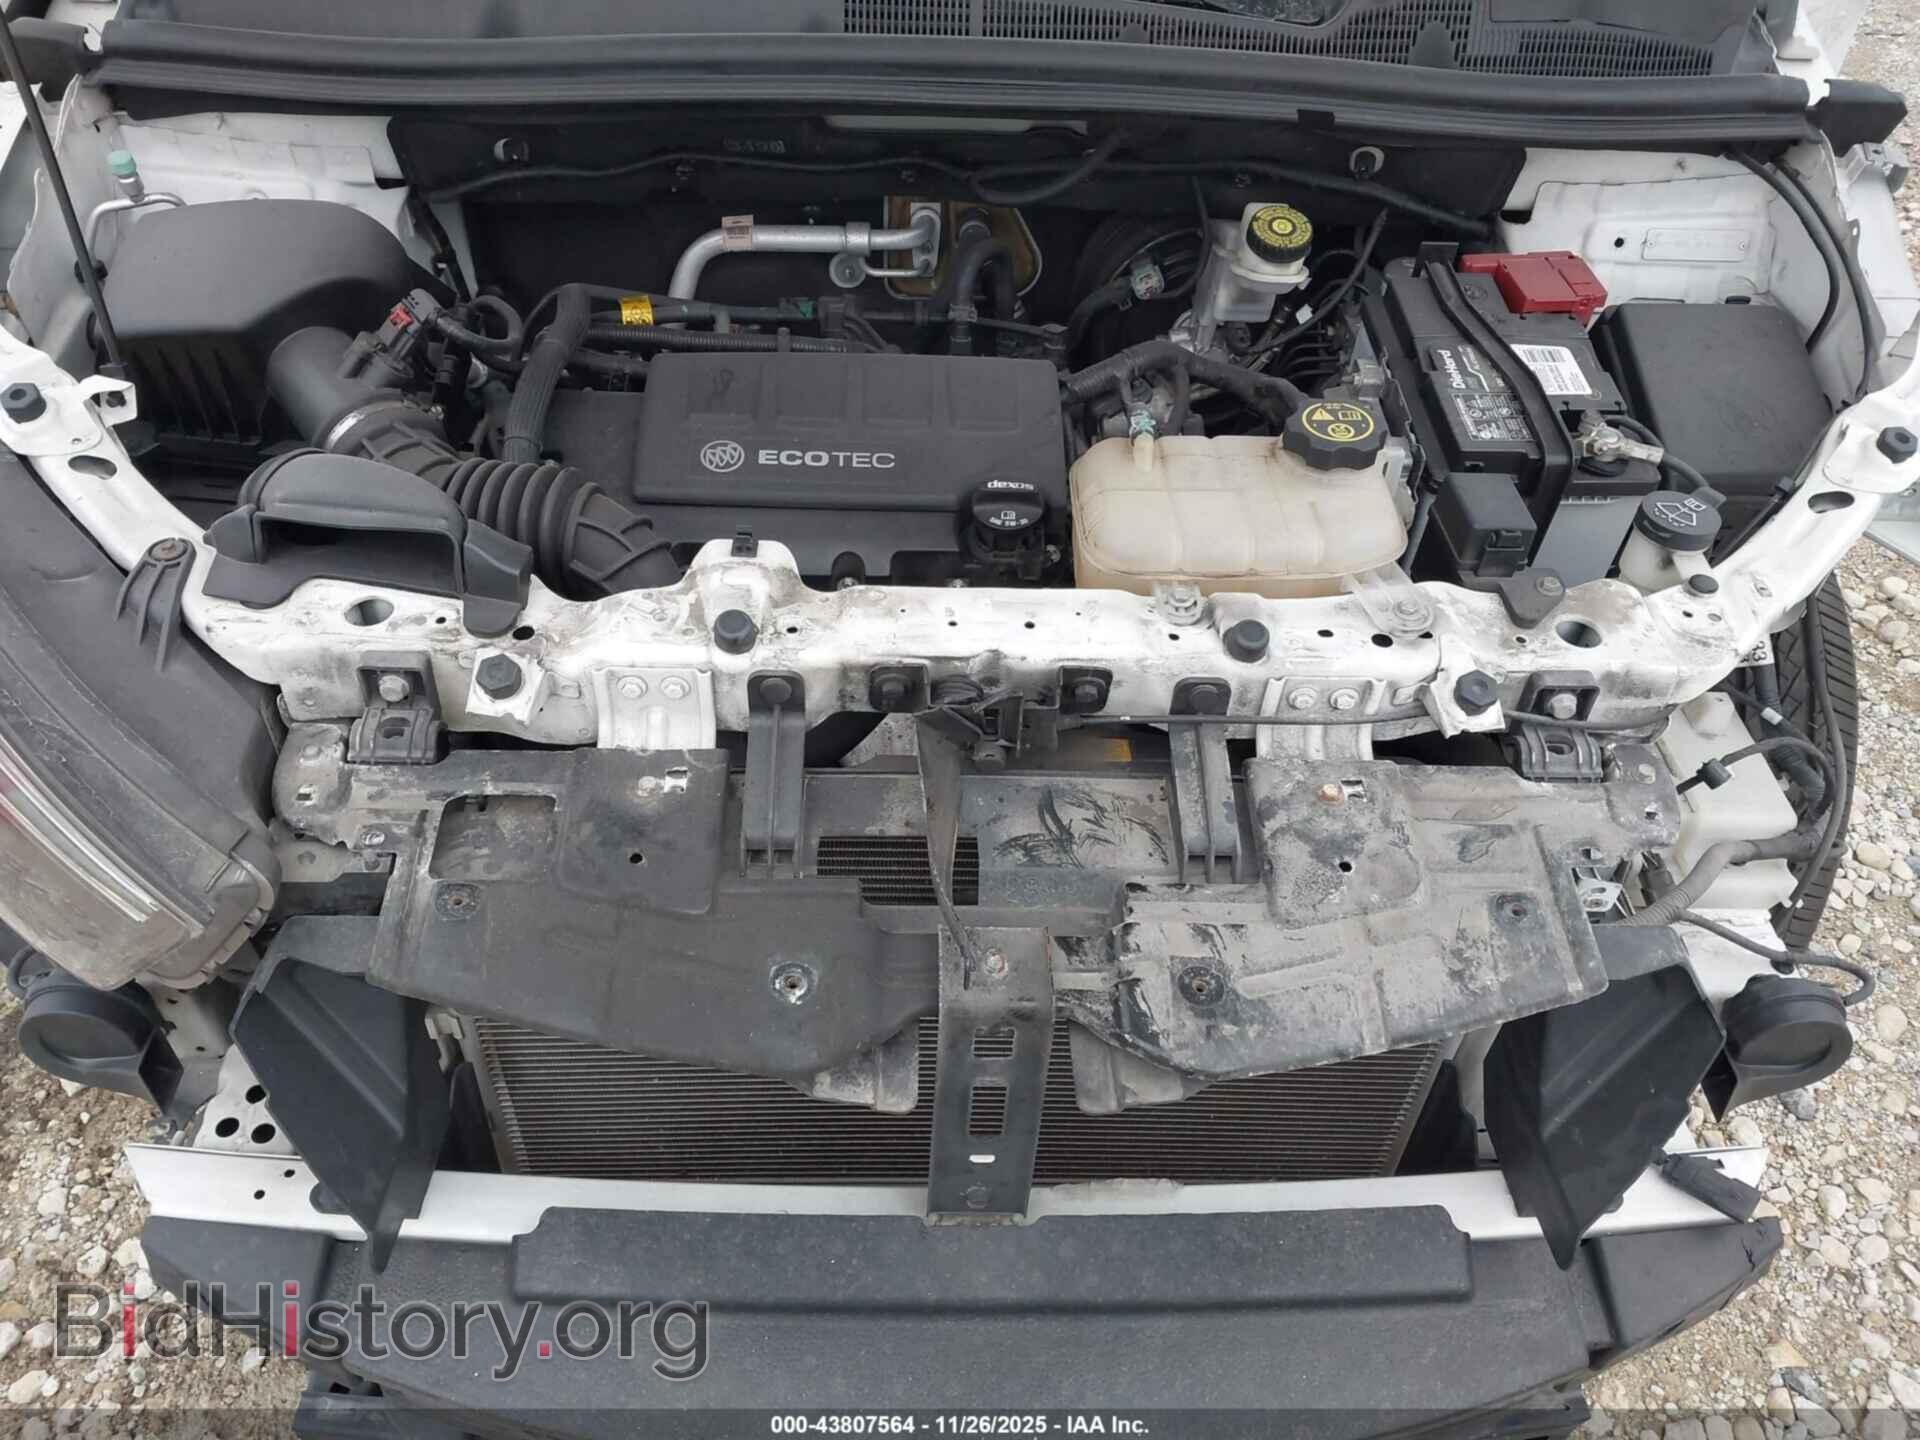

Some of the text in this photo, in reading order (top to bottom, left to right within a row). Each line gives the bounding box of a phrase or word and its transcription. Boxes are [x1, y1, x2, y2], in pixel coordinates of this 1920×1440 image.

[1437, 349, 1466, 389] DieHard
[757, 449, 896, 469] ECOTEC
[987, 479, 1035, 491] dexos
